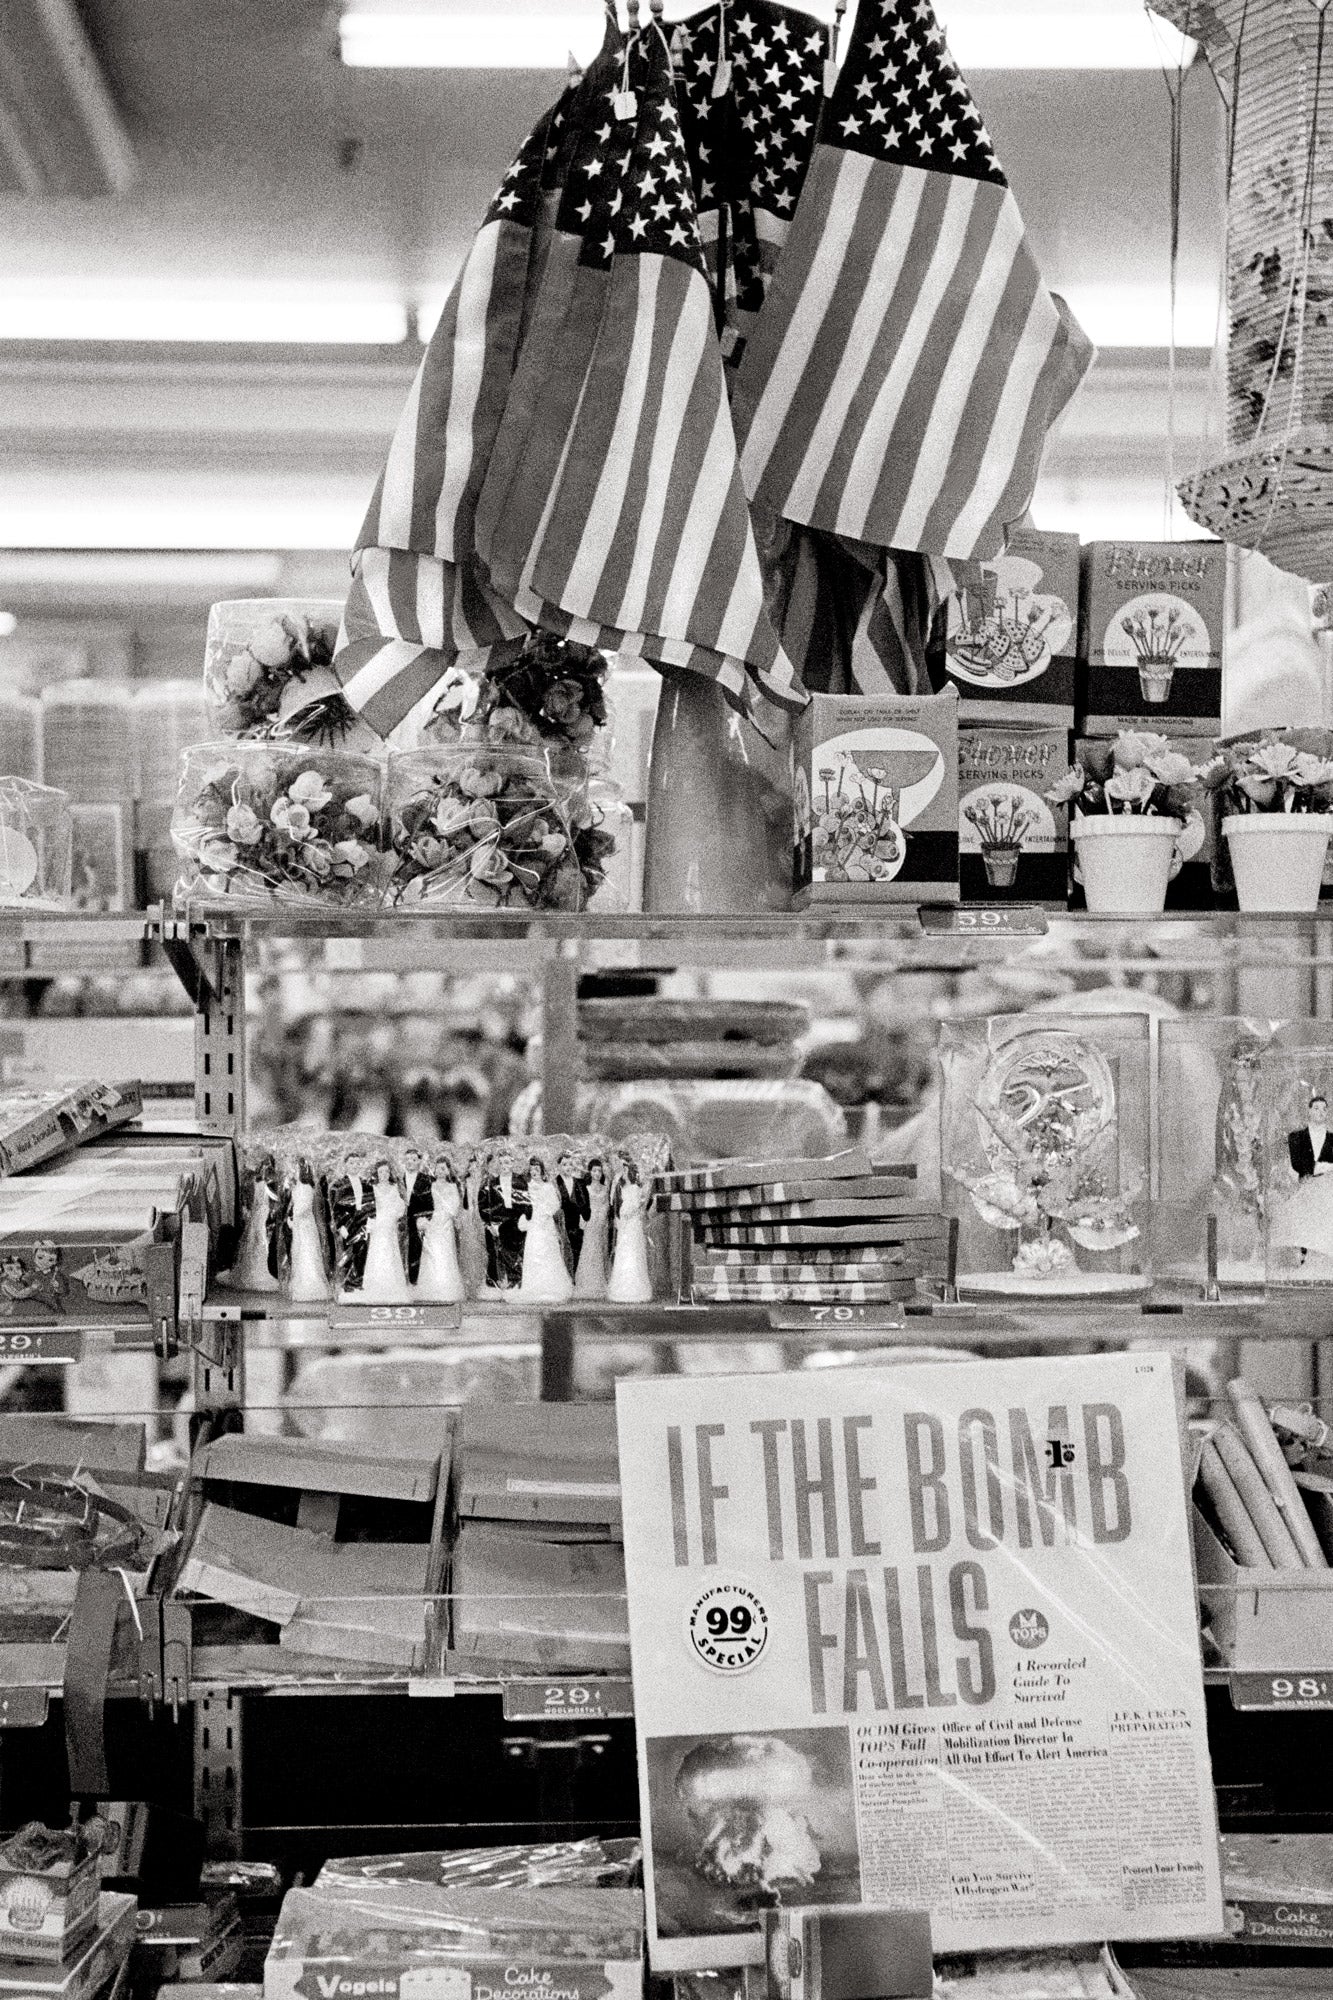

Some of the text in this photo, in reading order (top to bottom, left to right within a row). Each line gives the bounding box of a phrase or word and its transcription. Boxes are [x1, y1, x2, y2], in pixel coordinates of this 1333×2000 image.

[1116, 580, 1200, 591] SERVING PICKS
[958, 769, 1045, 780] SERVING PICKS
[666, 1403, 1132, 1567] IF THE BOMB
[690, 1585, 768, 1627] MANUFACTURERS
[804, 1561, 997, 1714] FALLS
[1011, 1626, 1046, 1641] TOPS
[698, 1637, 762, 1665] SPECIAL
[1027, 1657, 1087, 1671] Recorded
[1013, 1674, 1071, 1687] Guide To
[1014, 1690, 1066, 1703] Survival
[857, 1722, 936, 1736] OCDM Gives
[942, 1716, 1083, 1733] Office of Civil and Defense
[1111, 1720, 1192, 1732] PREPARATION
[859, 1737, 926, 1753] TOPS Full
[944, 1731, 1074, 1749] Mobilization Director In
[946, 1745, 1109, 1765] All Out Effort To Alert America
[859, 1757, 939, 1772] Co-operation
[1123, 1861, 1204, 1875] Protect Your Family
[951, 1871, 1031, 1883] Can You Survive
[962, 1885, 1010, 1896] Hydrogen
[1275, 1906, 1320, 1924] Cake
[504, 1967, 553, 1985] Cake
[474, 1985, 580, 2000] Decorations
